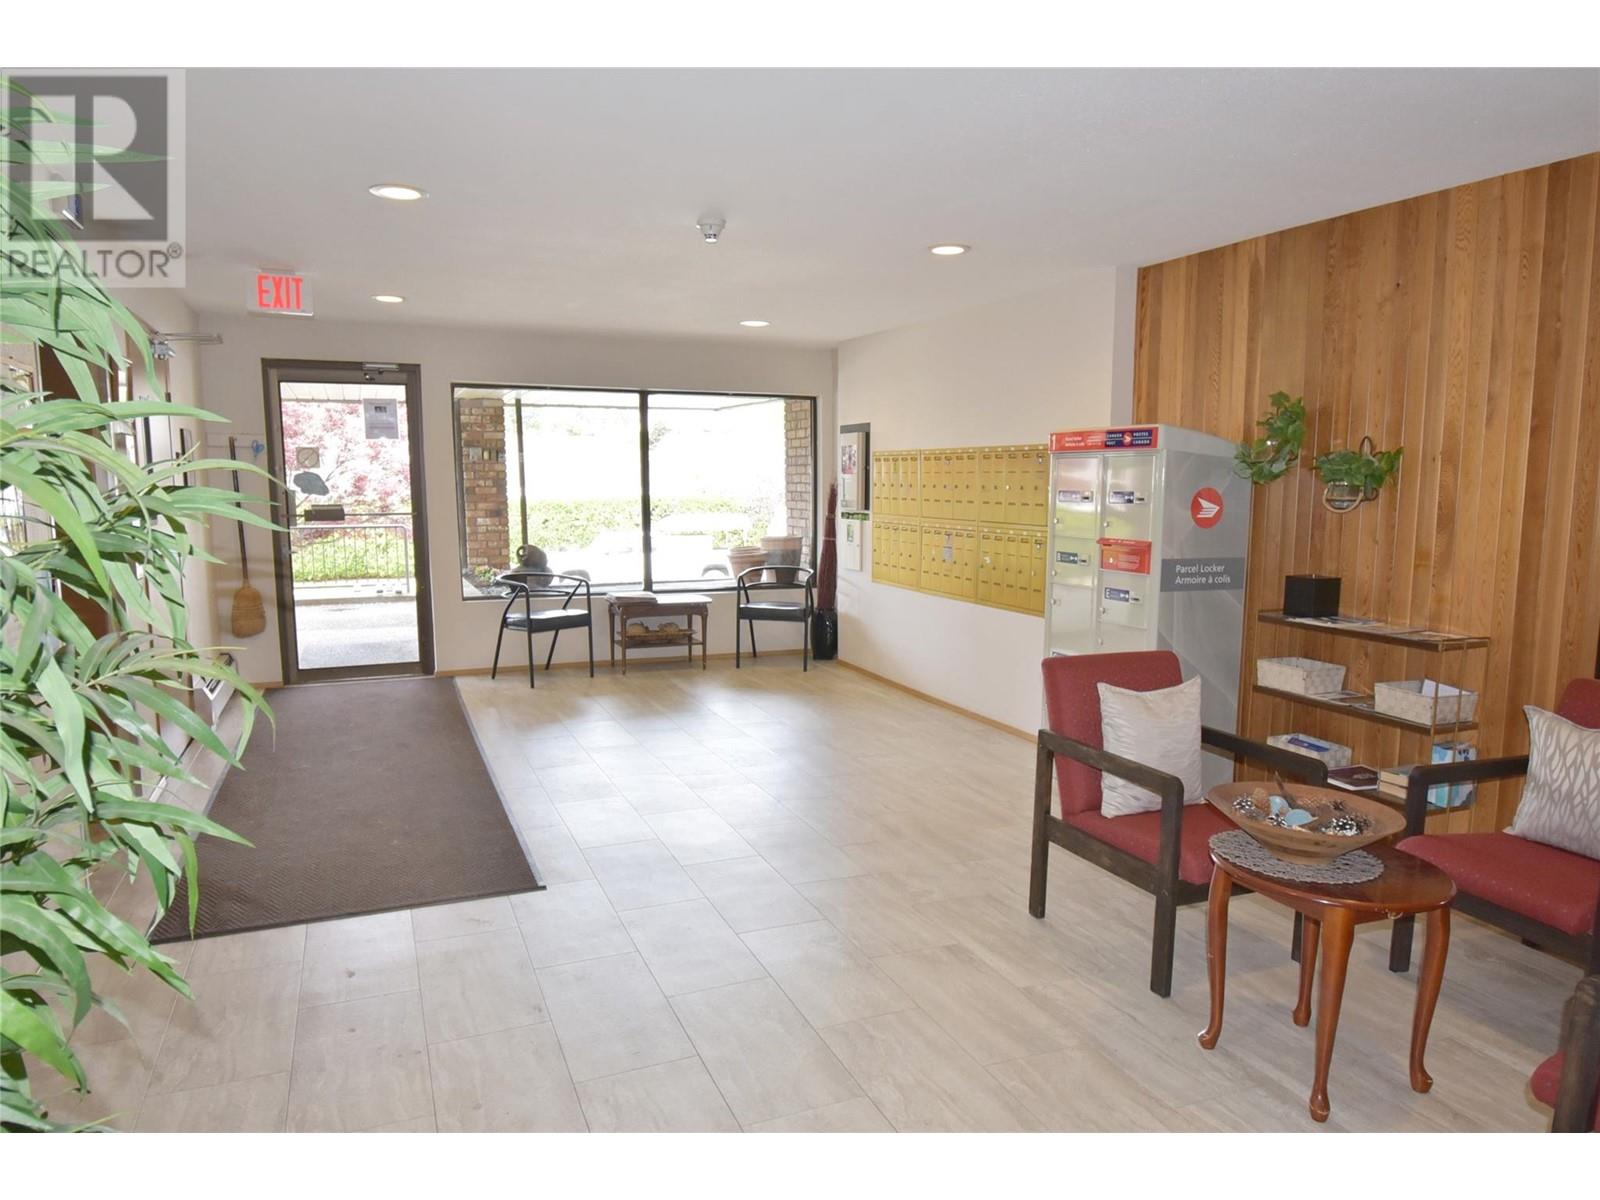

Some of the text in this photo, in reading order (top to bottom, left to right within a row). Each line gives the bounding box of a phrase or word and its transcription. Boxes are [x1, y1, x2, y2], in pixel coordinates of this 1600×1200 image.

[257, 274, 303, 310] EXIT
[1176, 564, 1225, 573] Parcel Locker
[1175, 575, 1231, 584] Armoire à colis
